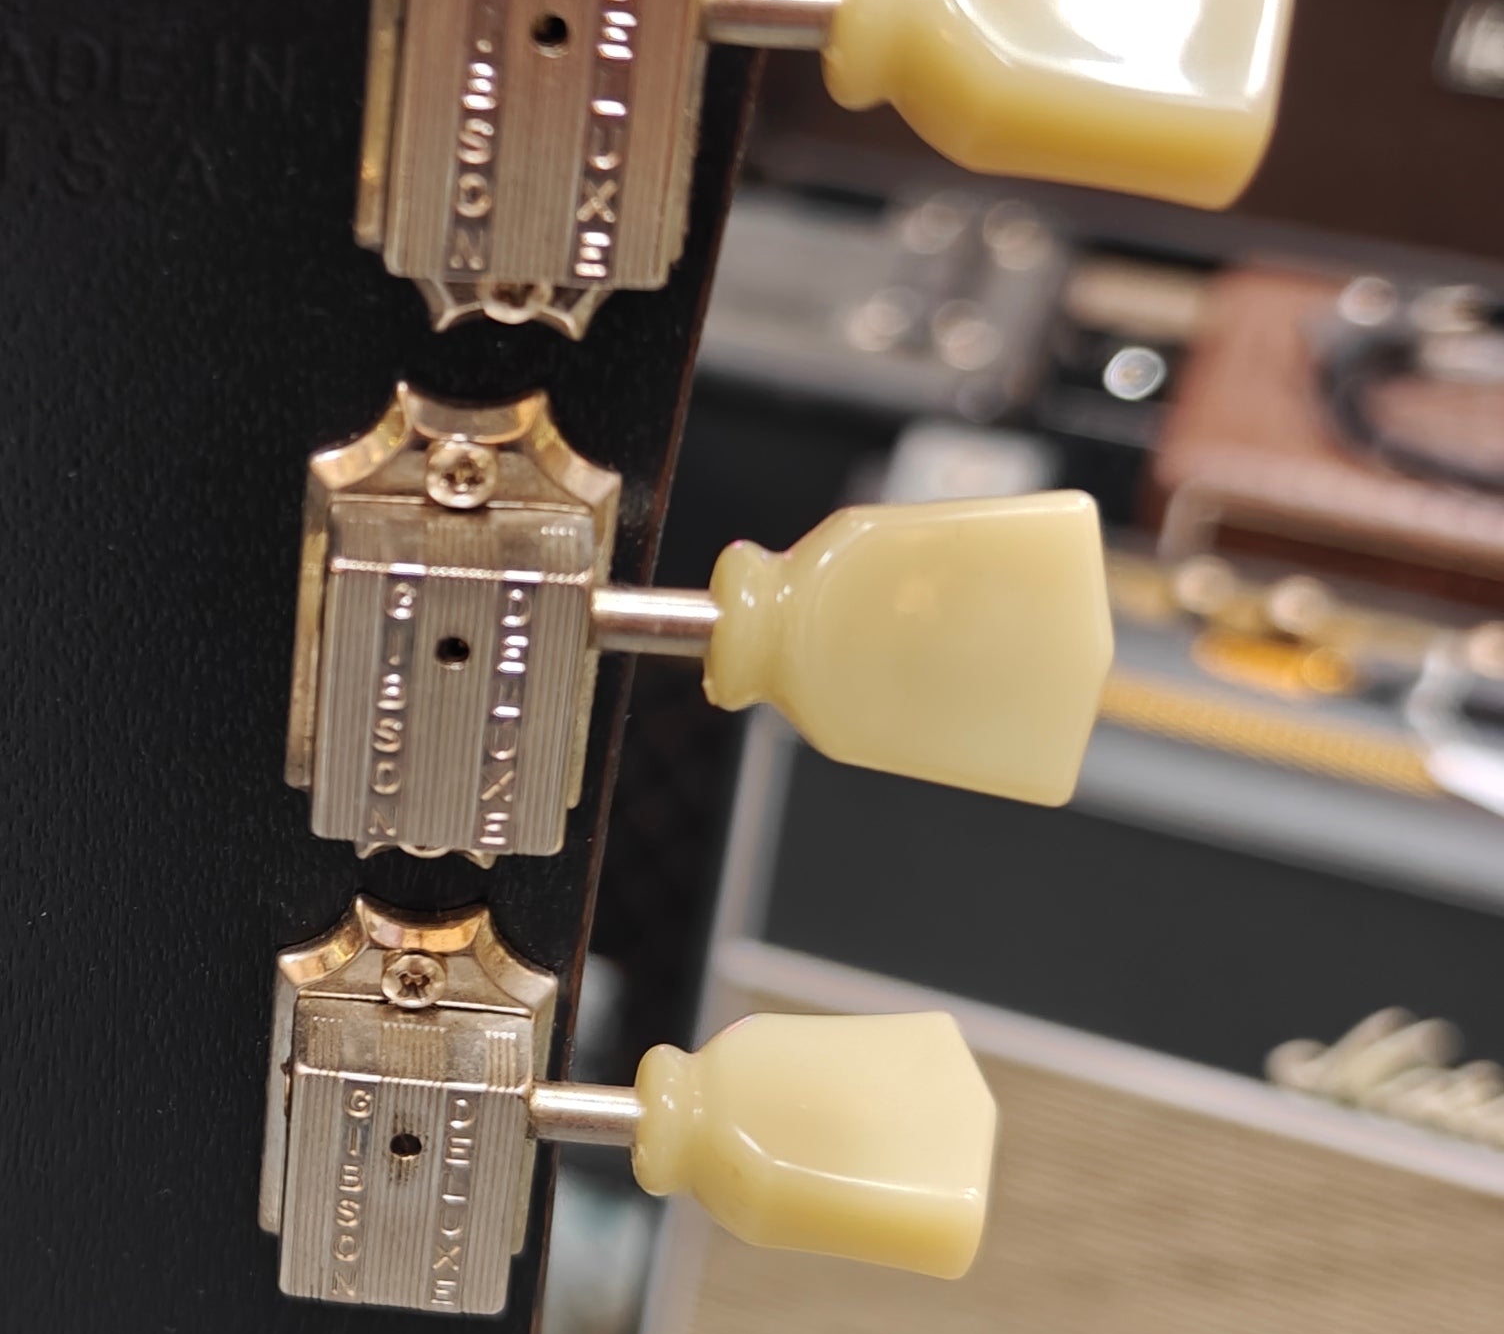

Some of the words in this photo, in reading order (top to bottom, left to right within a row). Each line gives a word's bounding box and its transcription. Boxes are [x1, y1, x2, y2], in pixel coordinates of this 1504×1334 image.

[213, 35, 300, 115] IN
[366, 581, 418, 839] GIBSON
[479, 587, 533, 847] DELUXE
[331, 1088, 374, 1297] GIBSON
[430, 1097, 475, 1306] DELUXE
